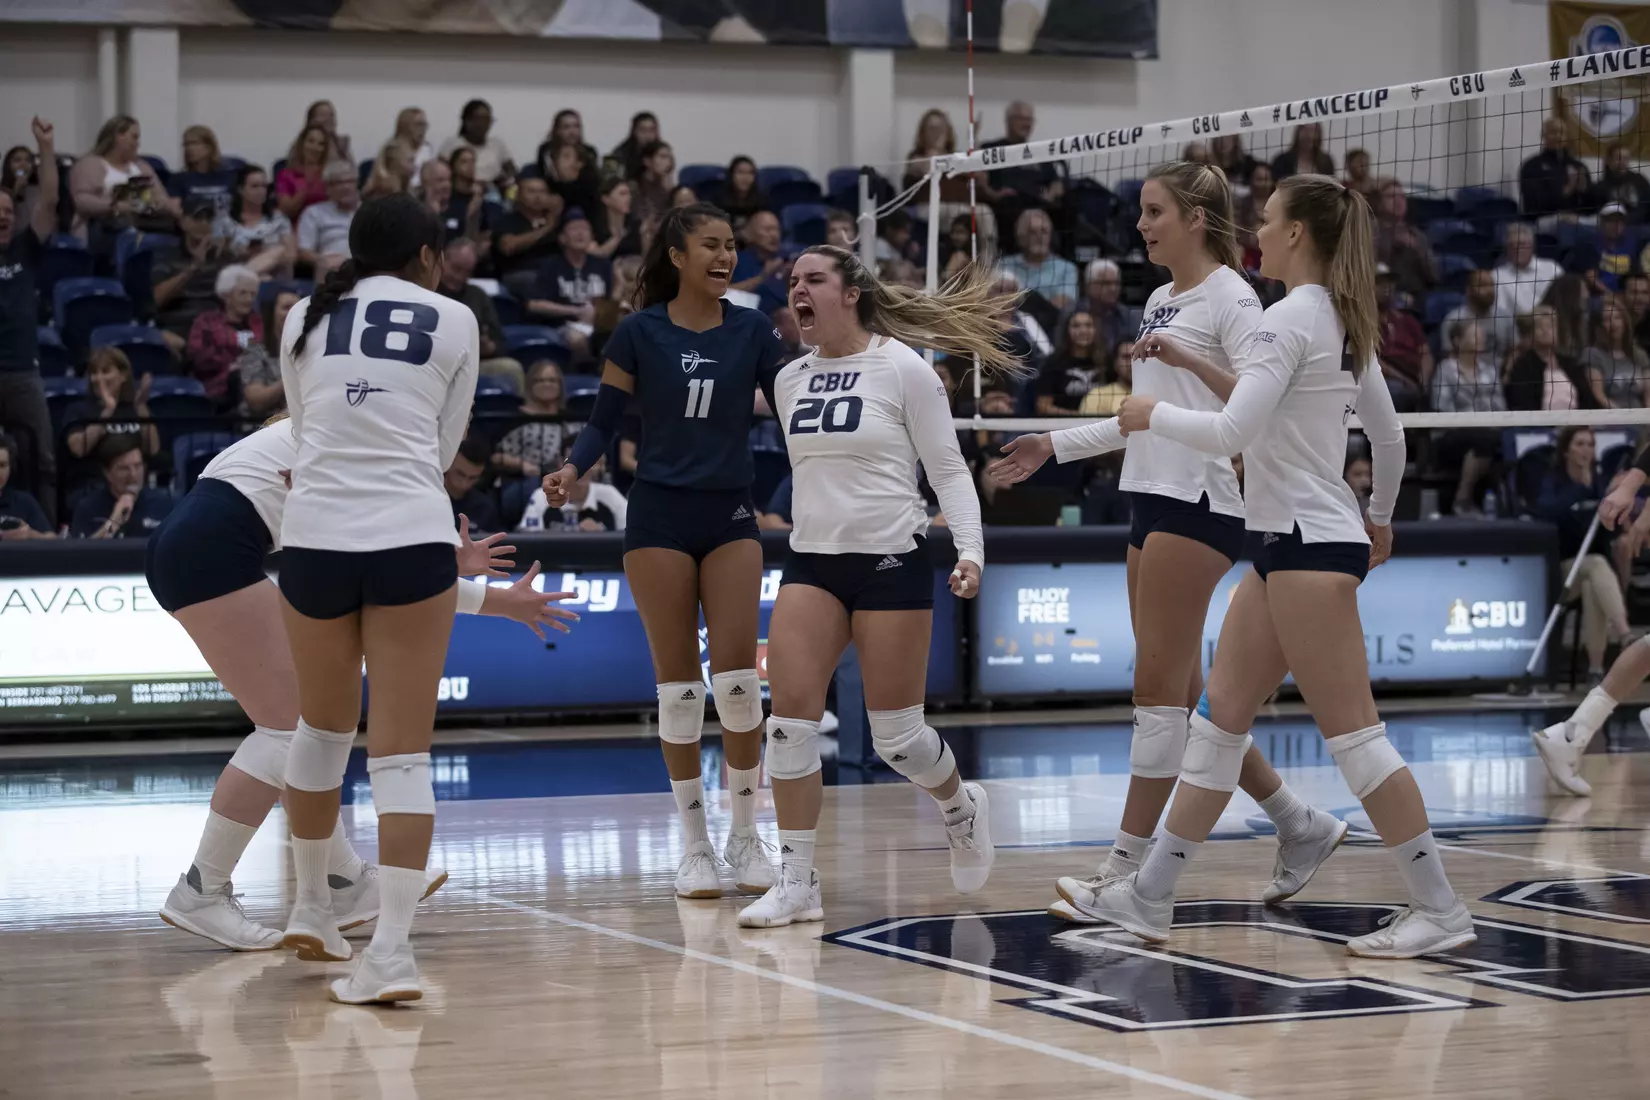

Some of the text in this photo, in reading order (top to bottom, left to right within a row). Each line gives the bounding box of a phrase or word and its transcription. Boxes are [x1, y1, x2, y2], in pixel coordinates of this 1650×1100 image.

[982, 147, 1007, 165] CBU
[1048, 126, 1143, 156] #LANCEUP
[1192, 115, 1220, 134] CBU
[1273, 88, 1389, 123] #LANCEUP
[1450, 73, 1485, 96] CBU
[322, 297, 440, 366] 18
[684, 378, 715, 419] 11
[808, 372, 862, 393] CBU
[789, 396, 864, 435] 20
[559, 572, 620, 612] by
[1018, 588, 1070, 603] ENJOY
[1018, 602, 1070, 624] FREE
[1472, 601, 1527, 628] CBU
